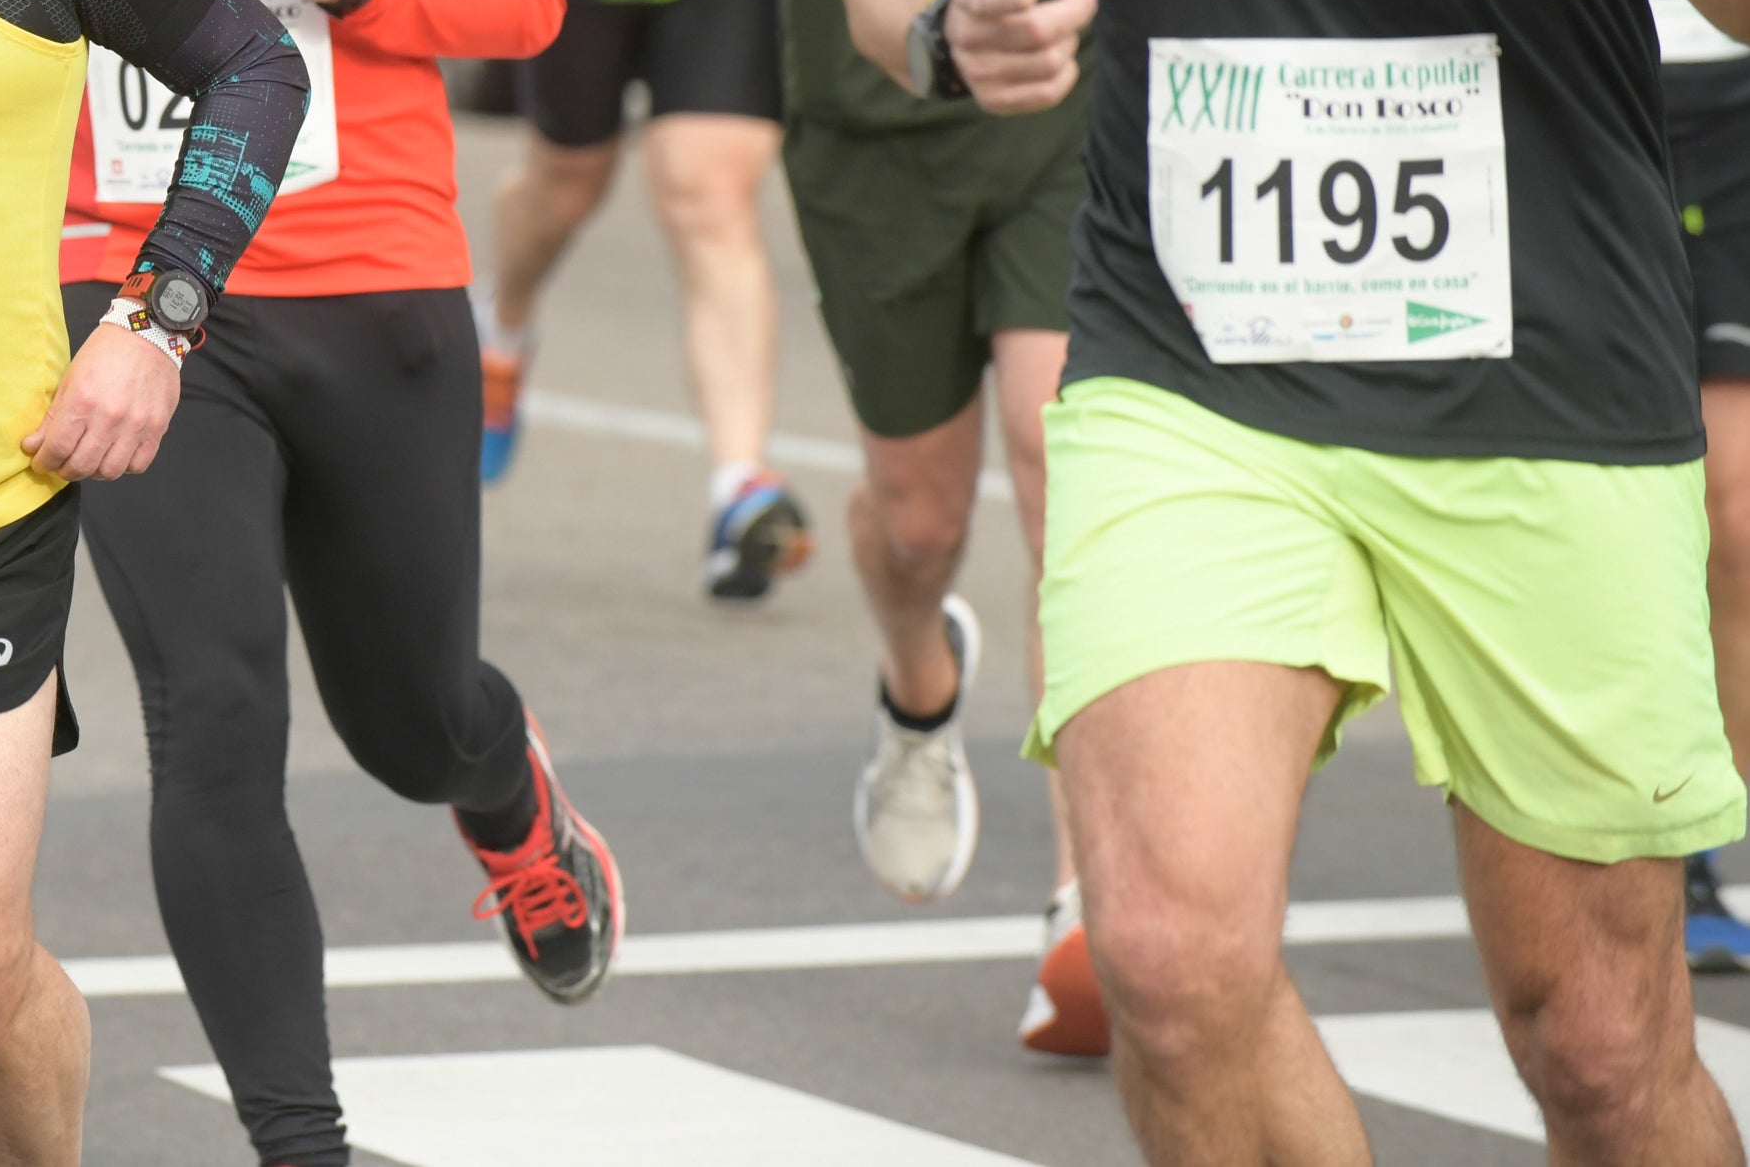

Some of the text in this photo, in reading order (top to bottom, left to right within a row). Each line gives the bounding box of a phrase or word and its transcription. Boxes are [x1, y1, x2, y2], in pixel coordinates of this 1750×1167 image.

[1162, 58, 1486, 133] XXIII Carrera Popular
[1201, 158, 1450, 264] 1195
